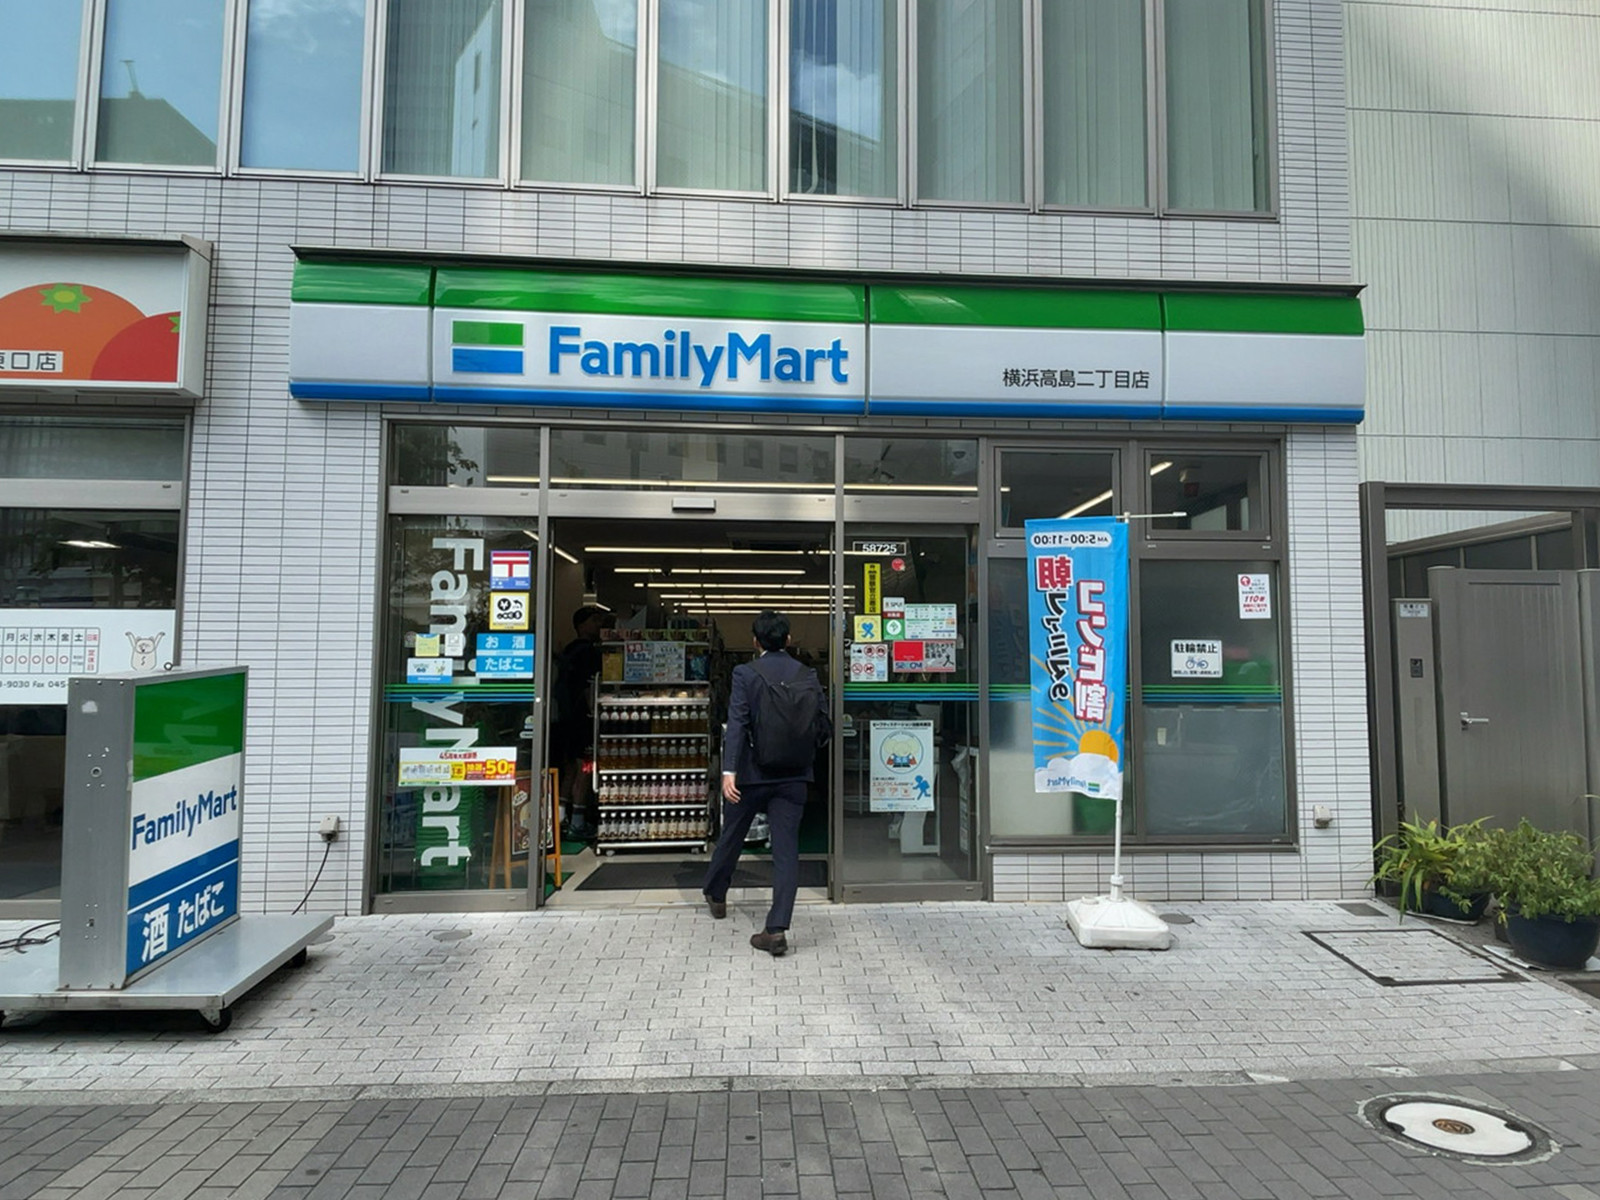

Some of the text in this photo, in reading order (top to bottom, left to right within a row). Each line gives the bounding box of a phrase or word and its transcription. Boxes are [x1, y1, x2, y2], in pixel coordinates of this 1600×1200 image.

[549, 325, 849, 388] FamilyMart
[1002, 368, 1150, 389] 横浜高島二丁目店
[862, 543, 897, 554] 58725
[6, 633, 15, 641] 月
[20, 633, 28, 641] 火
[34, 633, 42, 641] 水
[48, 633, 56, 641] 木
[61, 633, 69, 641] 金
[75, 633, 83, 641] 土
[1174, 643, 1218, 654] 駐輪禁止
[485, 657, 525, 671] たばこ
[0, 680, 30, 688] -9030
[131, 784, 238, 850] FamilyMart
[141, 881, 225, 963] 酒 たばこ
